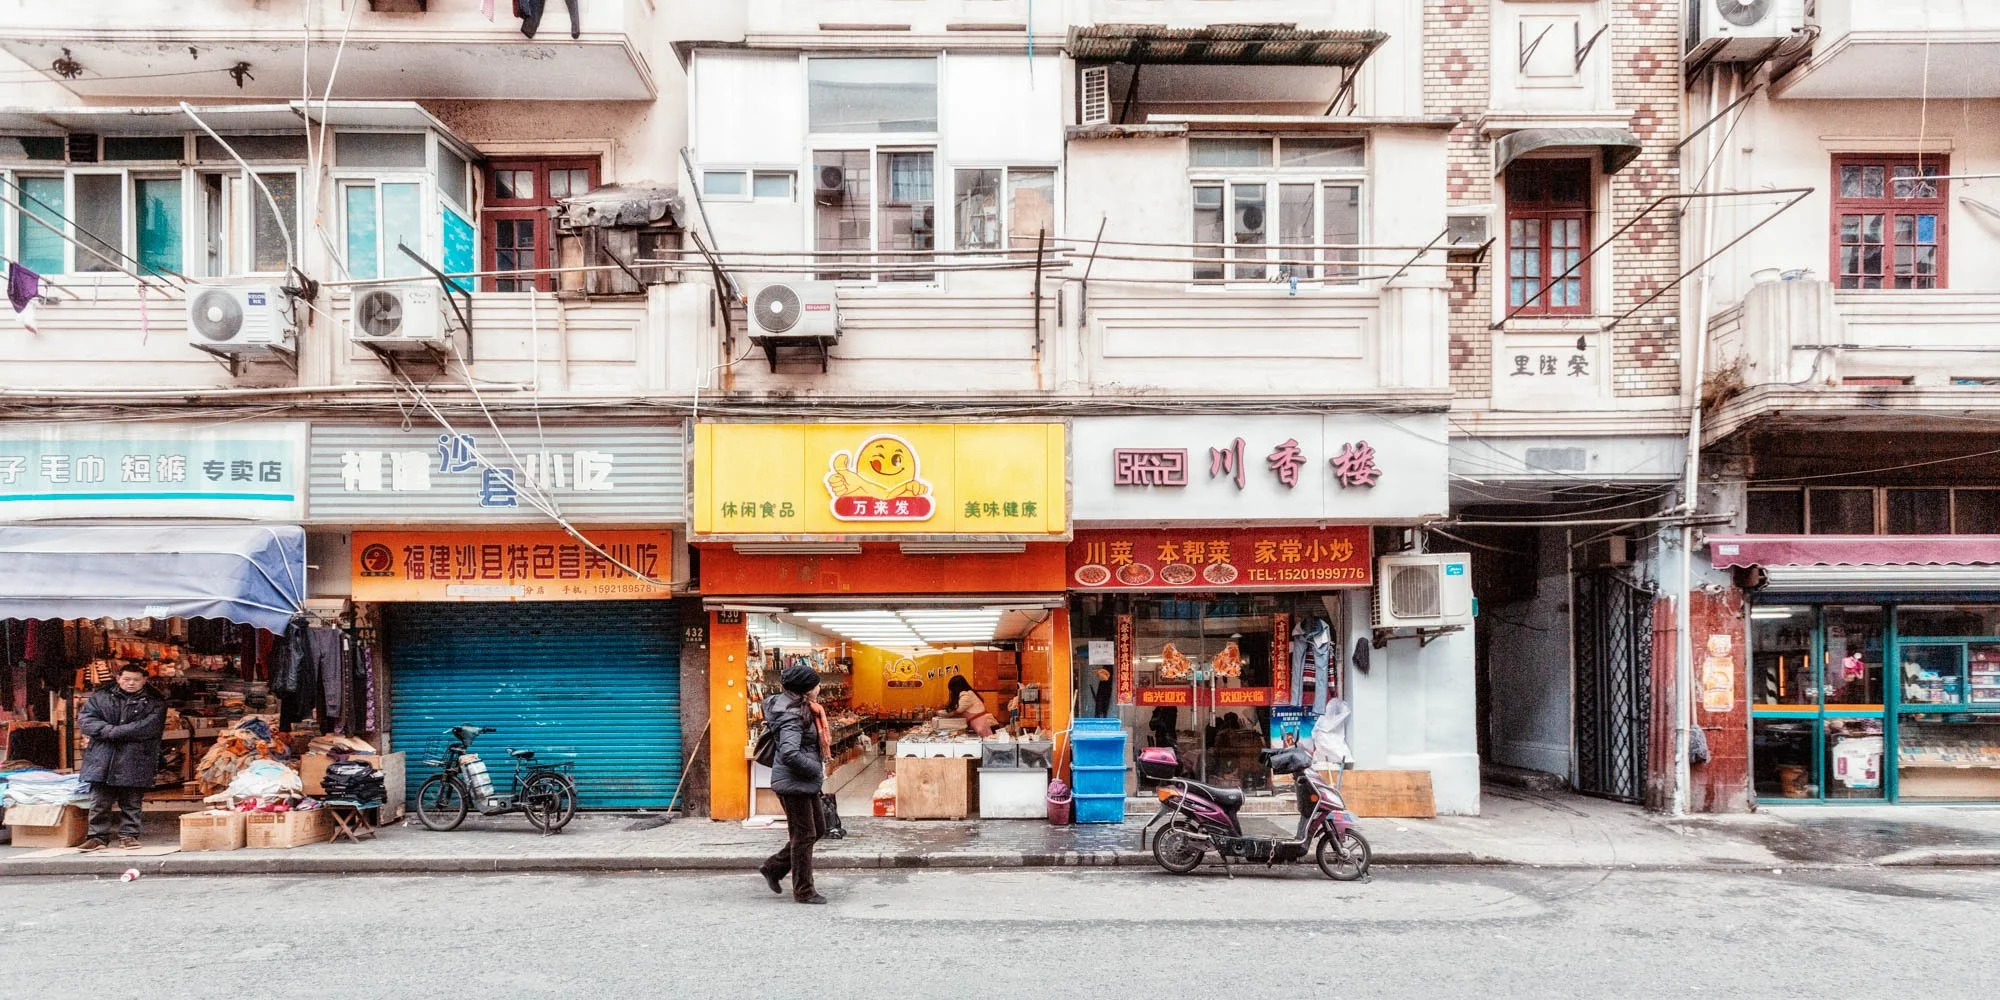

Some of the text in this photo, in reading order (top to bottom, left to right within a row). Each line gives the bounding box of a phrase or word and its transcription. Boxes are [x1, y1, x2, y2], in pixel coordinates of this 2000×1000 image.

[0, 454, 283, 485] 子 毛巾 短裤 专卖店
[721, 500, 796, 519] 休闲食品
[852, 499, 911, 516] 万来发
[963, 500, 1038, 518] 美味健康
[1084, 538, 1354, 566] 川菜 本帮菜 家常小炒
[402, 543, 659, 580] 福建沙县特色营养小吃
[1247, 567, 1365, 582] TEL:15201999776
[685, 627, 704, 637] 432
[1219, 690, 1264, 703] 欢迎光临
